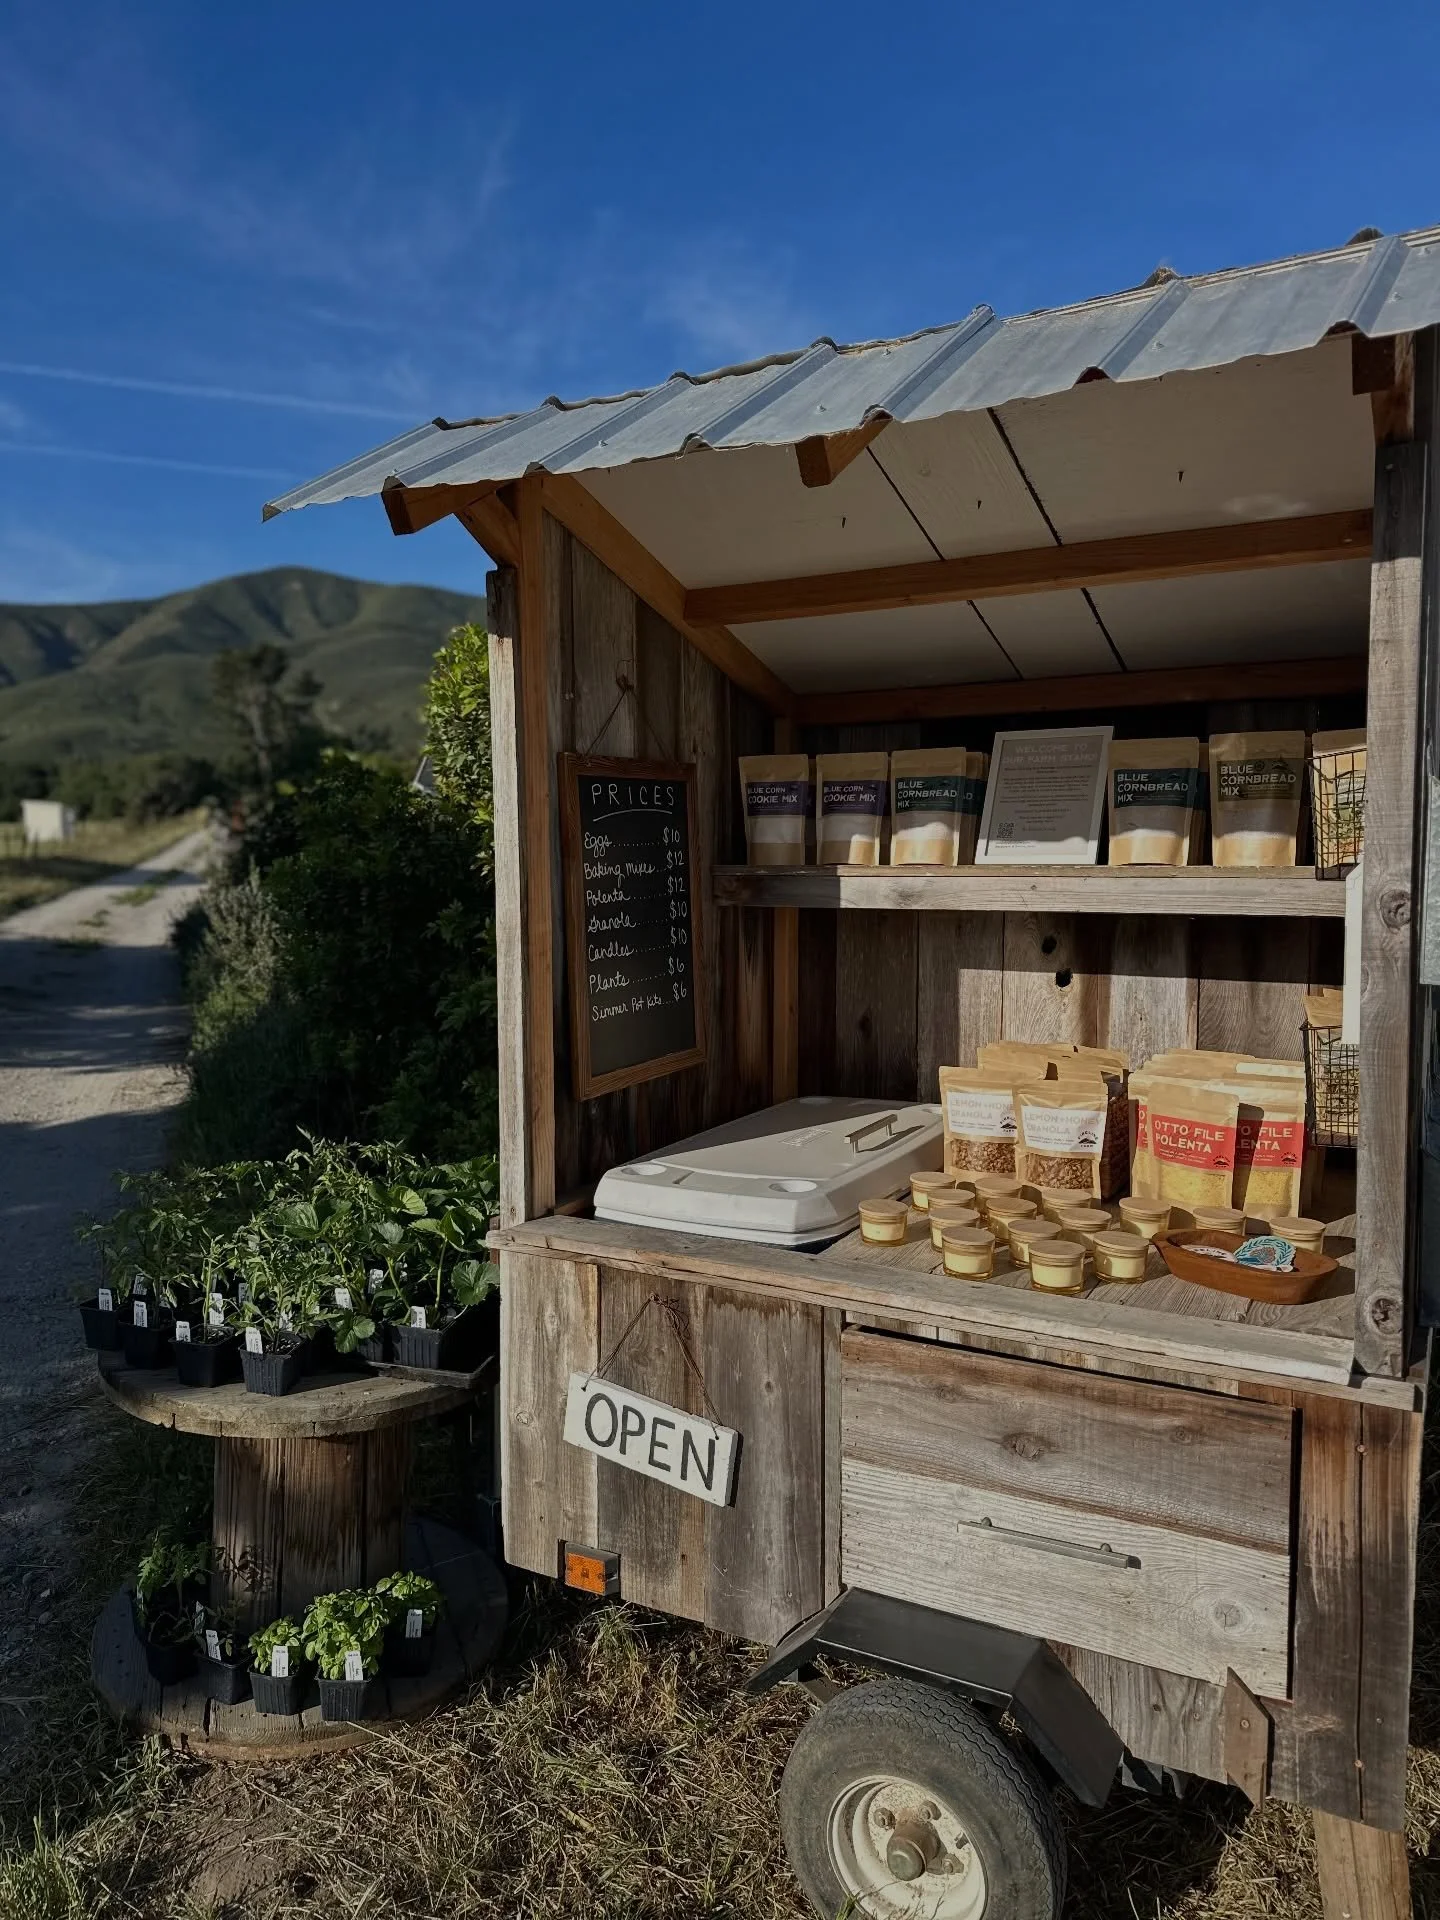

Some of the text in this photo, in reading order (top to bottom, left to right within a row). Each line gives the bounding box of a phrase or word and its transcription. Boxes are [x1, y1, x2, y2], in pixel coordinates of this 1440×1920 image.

[1220, 764, 1254, 775] BLUE
[1118, 773, 1150, 782] BLUE
[1220, 773, 1298, 786] CORNBREAD
[765, 786, 786, 794] CORN
[844, 785, 864, 793] CORN
[898, 780, 925, 789] BLUE
[1117, 782, 1189, 793] CORNBREAD
[591, 783, 674, 807] PRICES
[897, 789, 957, 799] CORNBREAD
[1220, 786, 1240, 797] MIX
[748, 794, 799, 804] COOKIE MIX
[824, 793, 877, 803] COOKIE MIX
[897, 799, 910, 809] MIX
[1117, 793, 1134, 804] MIX
[584, 826, 680, 858] Eggs $10
[584, 861, 626, 889] Baking
[666, 850, 685, 869] $12
[586, 875, 686, 907] Polenta $12
[588, 899, 688, 933] Granola $10
[588, 926, 688, 962] Candles $10
[589, 956, 685, 995] Plants $6
[592, 981, 687, 1021] Simmer Pot Kits $6
[1154, 1120, 1189, 1136] OTTO
[1193, 1128, 1225, 1142] FILE
[1258, 1126, 1293, 1138] FILE
[1155, 1133, 1212, 1154] POLENTA
[584, 1392, 716, 1491] OPEN
